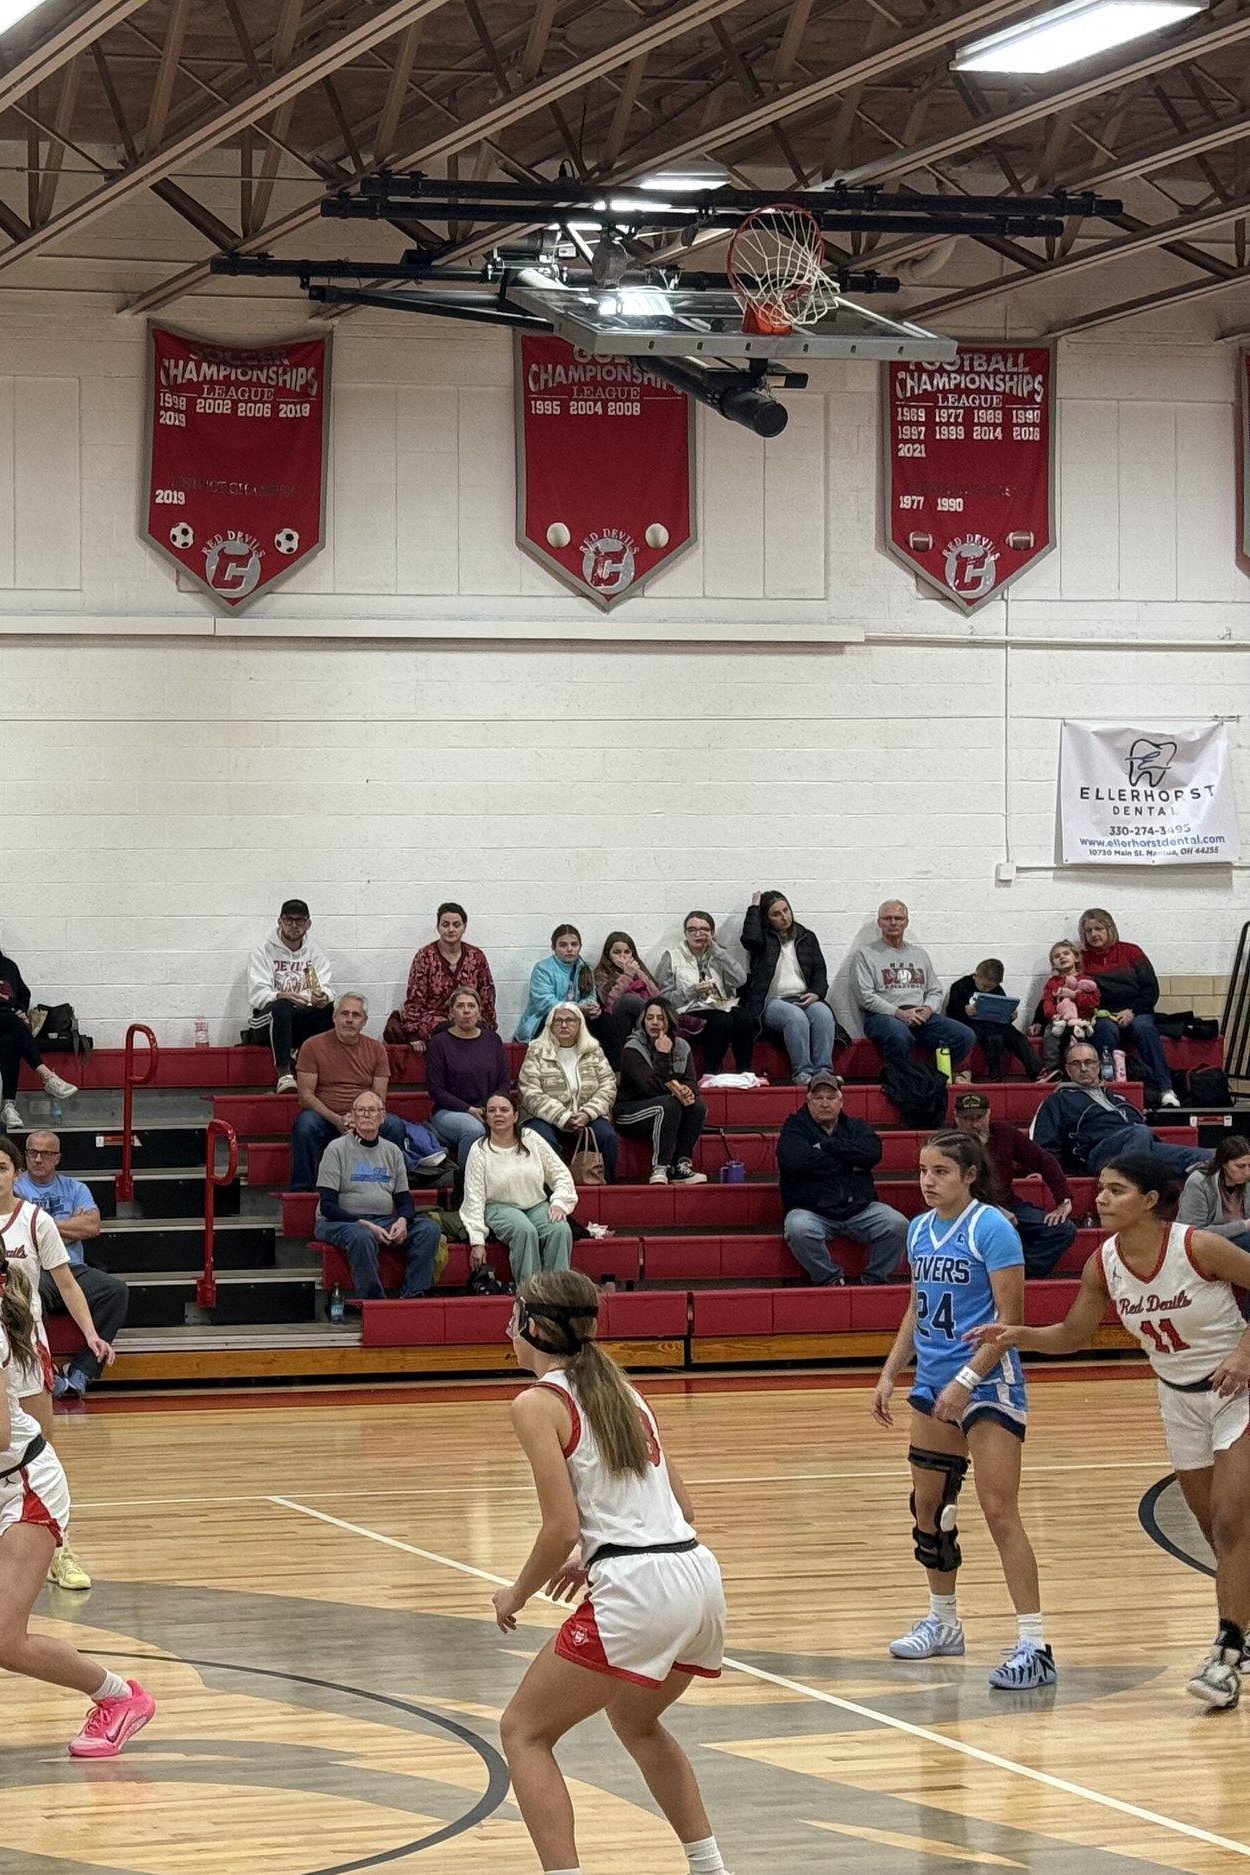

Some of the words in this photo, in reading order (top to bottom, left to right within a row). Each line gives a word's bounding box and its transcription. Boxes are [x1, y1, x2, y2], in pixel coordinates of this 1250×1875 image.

[160, 358, 318, 397] CHAMPIONSHIPS
[528, 363, 682, 395] CHAMPIONSH
[201, 384, 275, 401] LEAGUE
[571, 385, 641, 400] LEAGUE
[895, 370, 1044, 403] CHAMPIONSHIPS
[195, 398, 232, 414] 2002
[237, 402, 272, 417] 2006
[530, 400, 561, 415] 1995
[569, 401, 603, 415] 2004
[607, 401, 641, 416] 2008
[937, 393, 1003, 408] LEAGUE
[159, 410, 186, 427] 2019
[935, 408, 964, 423] 1977
[935, 426, 965, 440] 1999
[972, 426, 1003, 440] 2014
[897, 443, 926, 458] 2021
[155, 489, 186, 505] 2019
[899, 495, 925, 510] 1977
[936, 497, 964, 512] 1990
[227, 530, 266, 558] DEVILS
[603, 528, 640, 554] DEVILS
[1080, 785, 1215, 802] ELLERHORST
[1112, 806, 1177, 816] DENTAL
[1079, 835, 1226, 849] www.ellerhorstdental.com
[1146, 849, 1179, 857] Maua,
[912, 1255, 971, 1285] OVERS
[1119, 1294, 1144, 1315] Red
[916, 1289, 956, 1341] 24
[1140, 1318, 1191, 1354] 11
